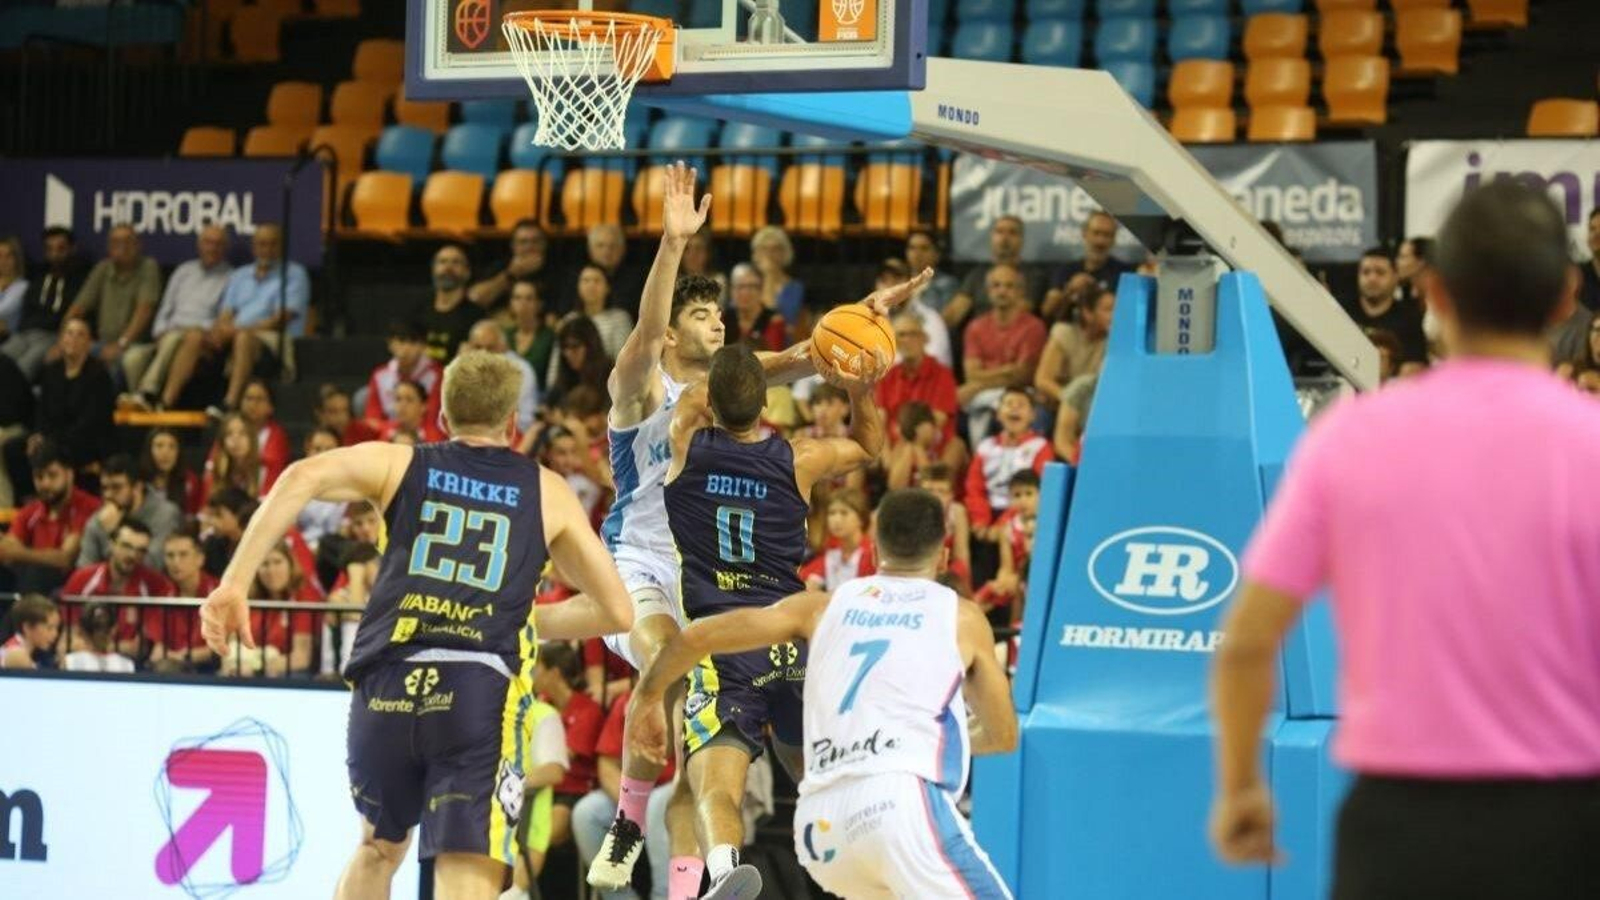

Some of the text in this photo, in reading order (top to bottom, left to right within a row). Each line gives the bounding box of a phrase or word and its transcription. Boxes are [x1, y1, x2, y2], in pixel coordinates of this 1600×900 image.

[938, 104, 980, 126] MONDO
[1232, 177, 1364, 222] aneda
[427, 468, 521, 507] KRIKKE
[705, 473, 768, 499] BRITO
[408, 500, 512, 592] 23
[716, 505, 756, 563] 0
[1114, 542, 1210, 601] HR
[842, 608, 923, 630] FIGUERAS
[1060, 623, 1226, 652] HORMIRAP
[838, 639, 891, 716] 7
